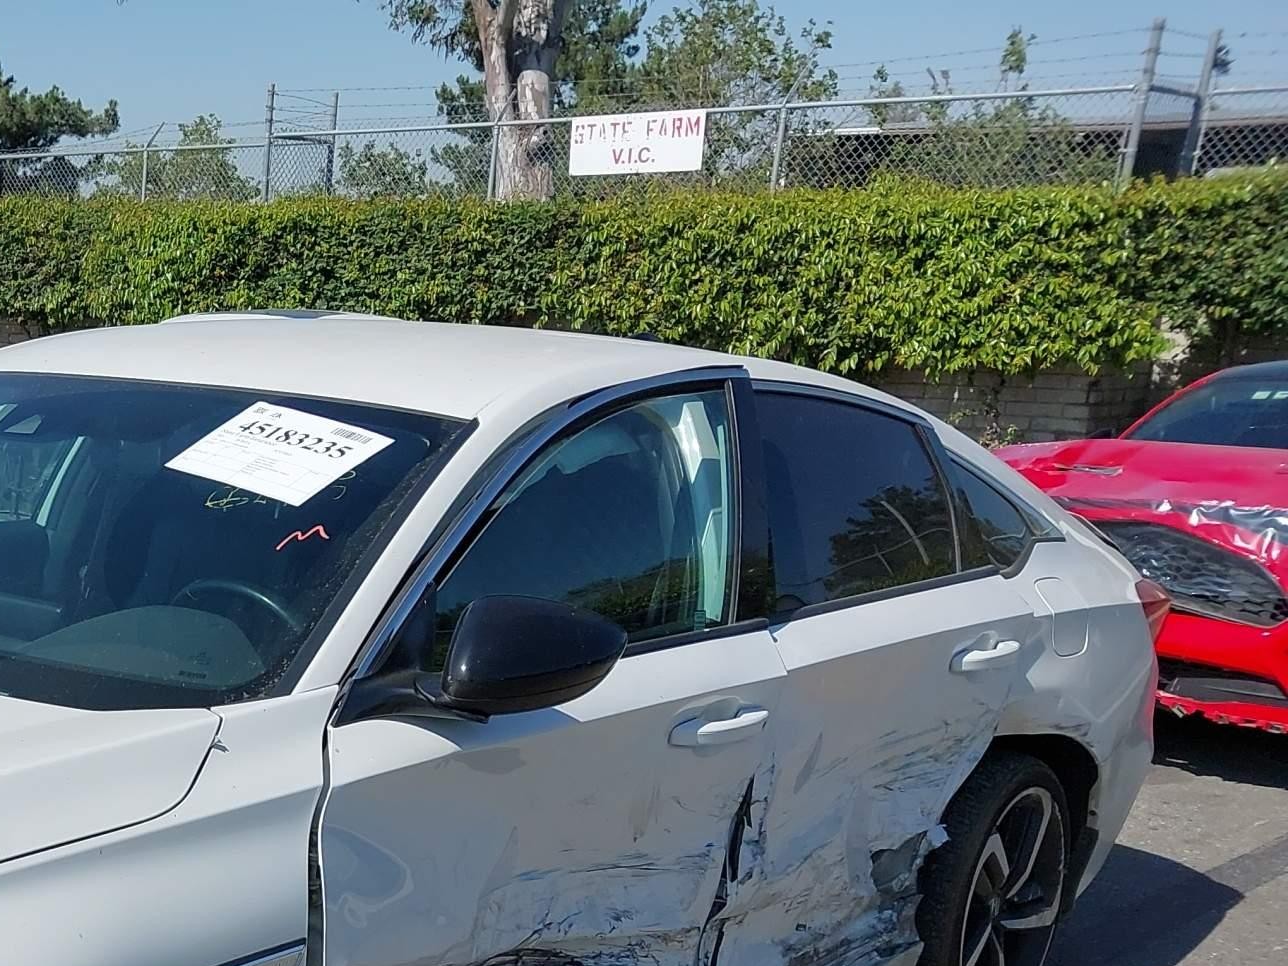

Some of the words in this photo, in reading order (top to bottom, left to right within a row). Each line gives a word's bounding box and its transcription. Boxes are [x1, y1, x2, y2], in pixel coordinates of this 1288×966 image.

[574, 121, 633, 144] STATE
[647, 115, 701, 139] FARM
[612, 146, 656, 165] V.I.C.
[238, 420, 355, 459] 45183235
